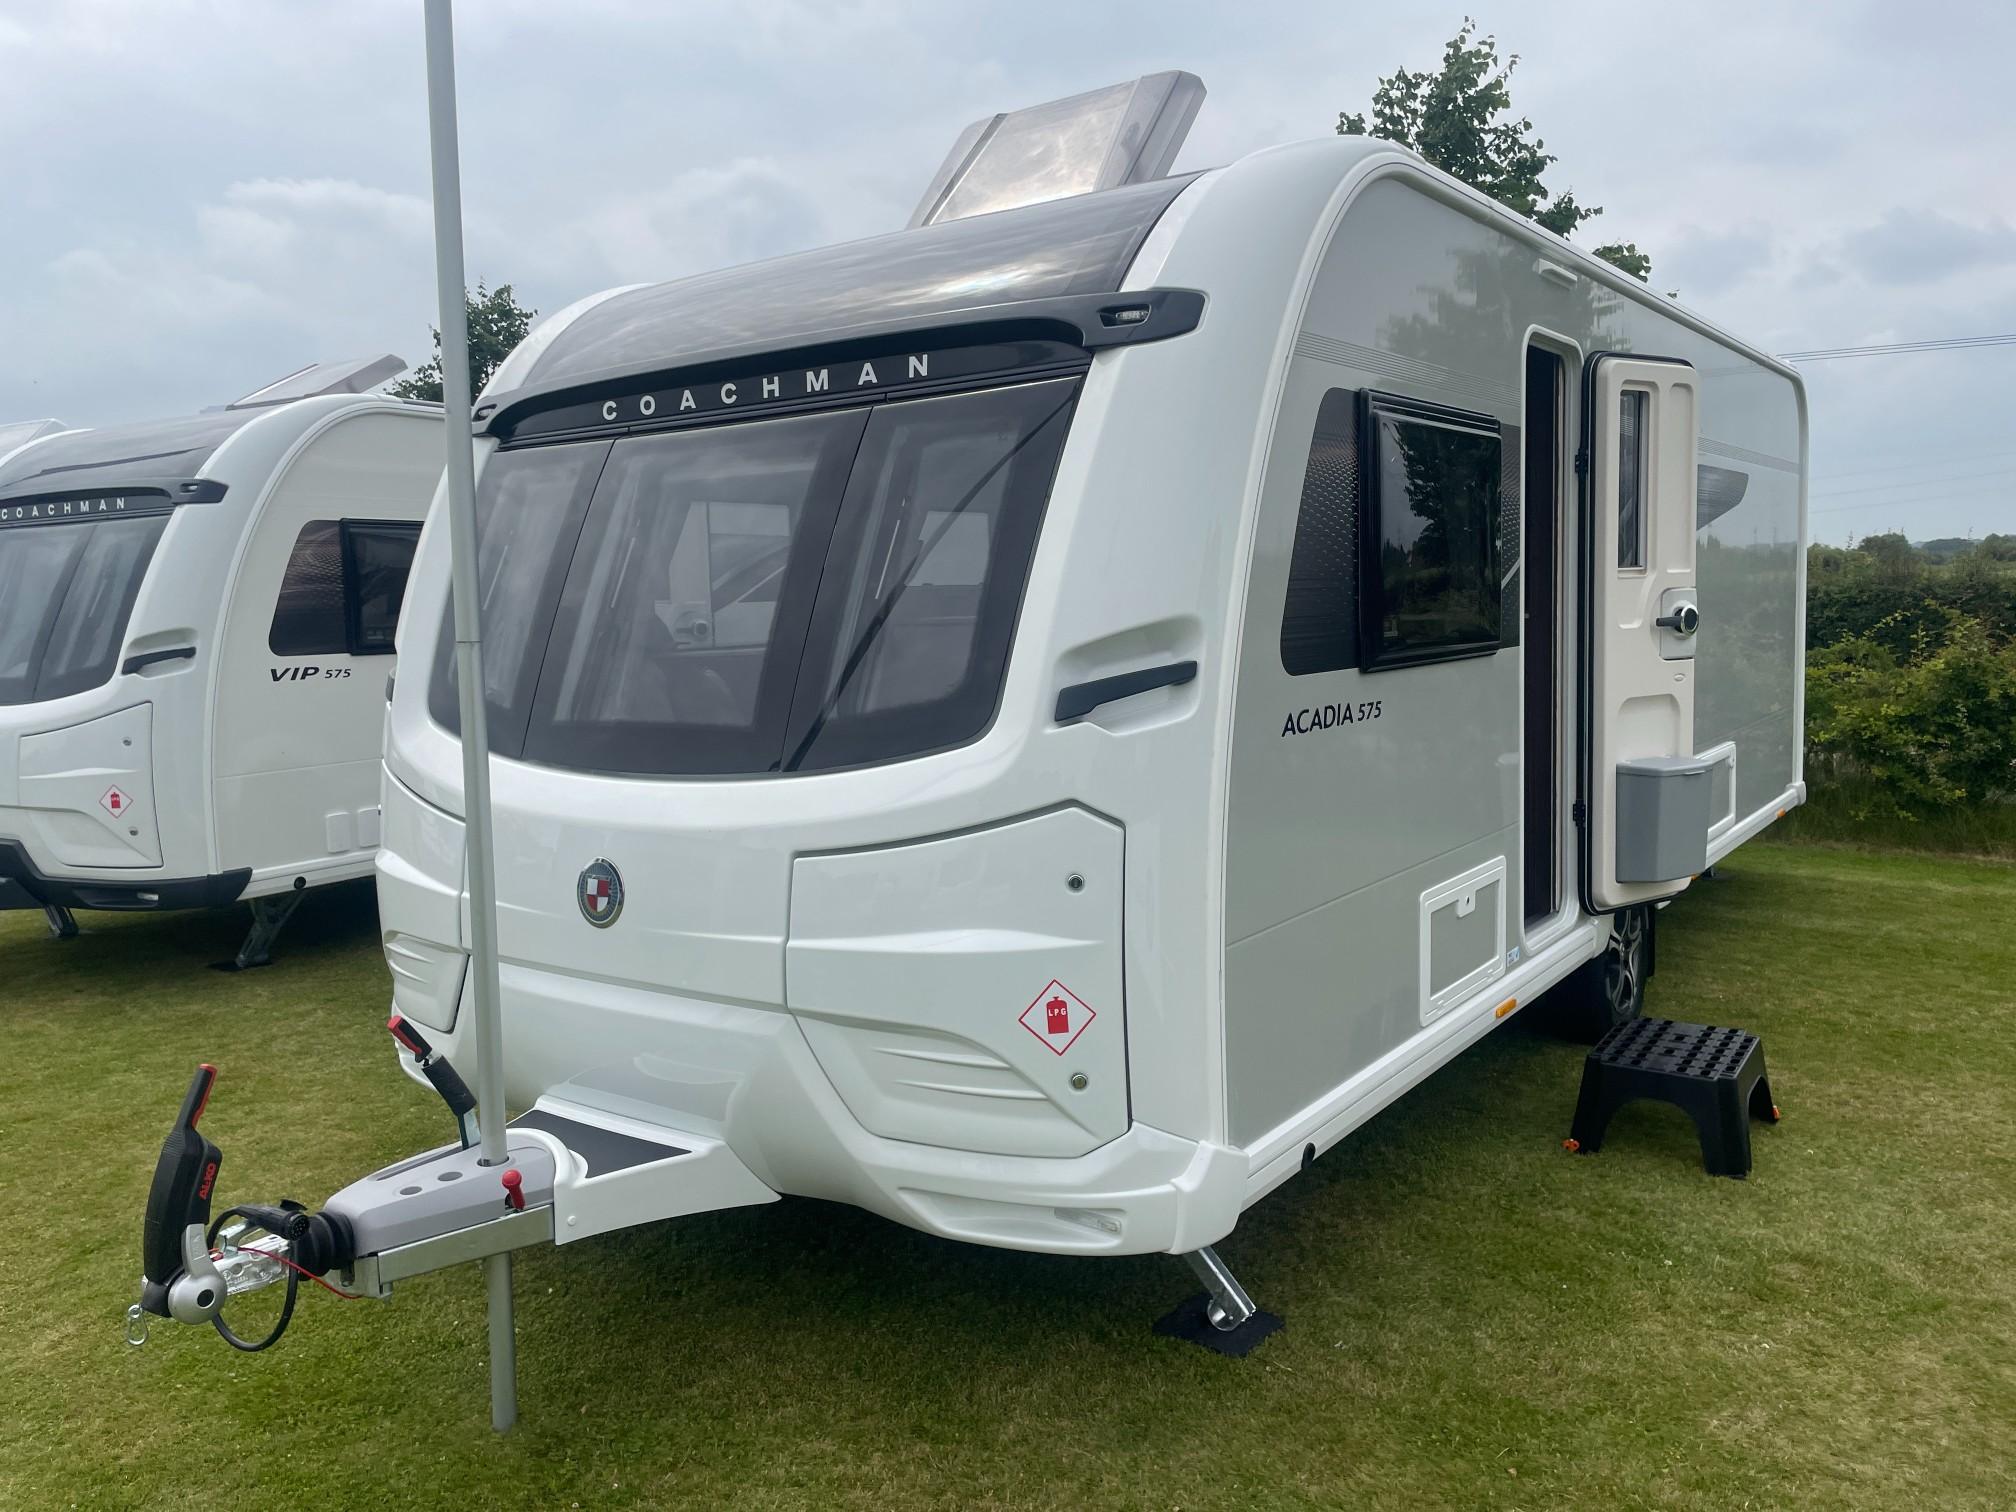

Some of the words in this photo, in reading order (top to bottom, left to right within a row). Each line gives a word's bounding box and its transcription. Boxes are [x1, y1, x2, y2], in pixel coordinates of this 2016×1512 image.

[602, 353, 928, 421] COACHMAN
[1, 497, 125, 520] COACHMAN
[270, 666, 320, 682] VIP
[324, 668, 352, 679] 575
[1281, 702, 1354, 738] ACADIA
[1357, 700, 1382, 722] 575
[1048, 1007, 1067, 1017] LPG
